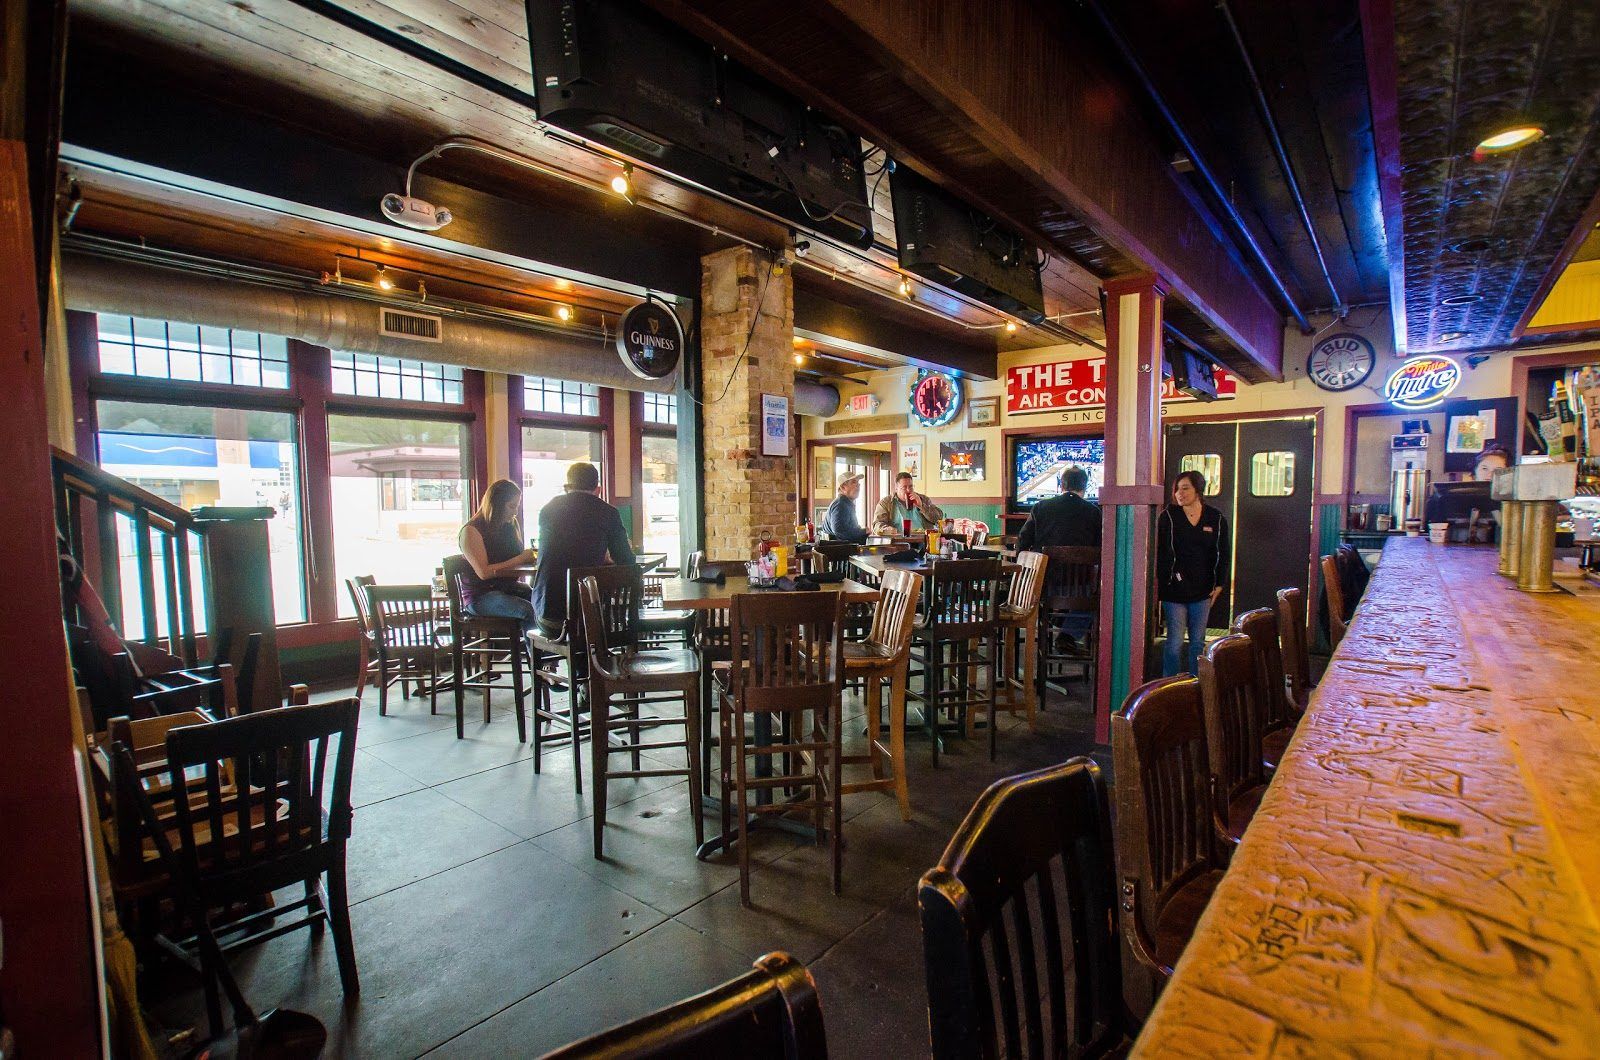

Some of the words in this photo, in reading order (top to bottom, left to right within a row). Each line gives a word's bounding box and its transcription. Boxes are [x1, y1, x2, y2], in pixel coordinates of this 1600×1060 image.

[631, 331, 675, 351] GUINNESS
[1321, 339, 1360, 356] BUD
[1016, 362, 1073, 390] THE
[1406, 360, 1452, 377] Miller
[1388, 369, 1456, 401] Lite
[853, 395, 868, 410] EXIT
[1019, 392, 1053, 409] AIR
[1061, 411, 1105, 422] SINC
